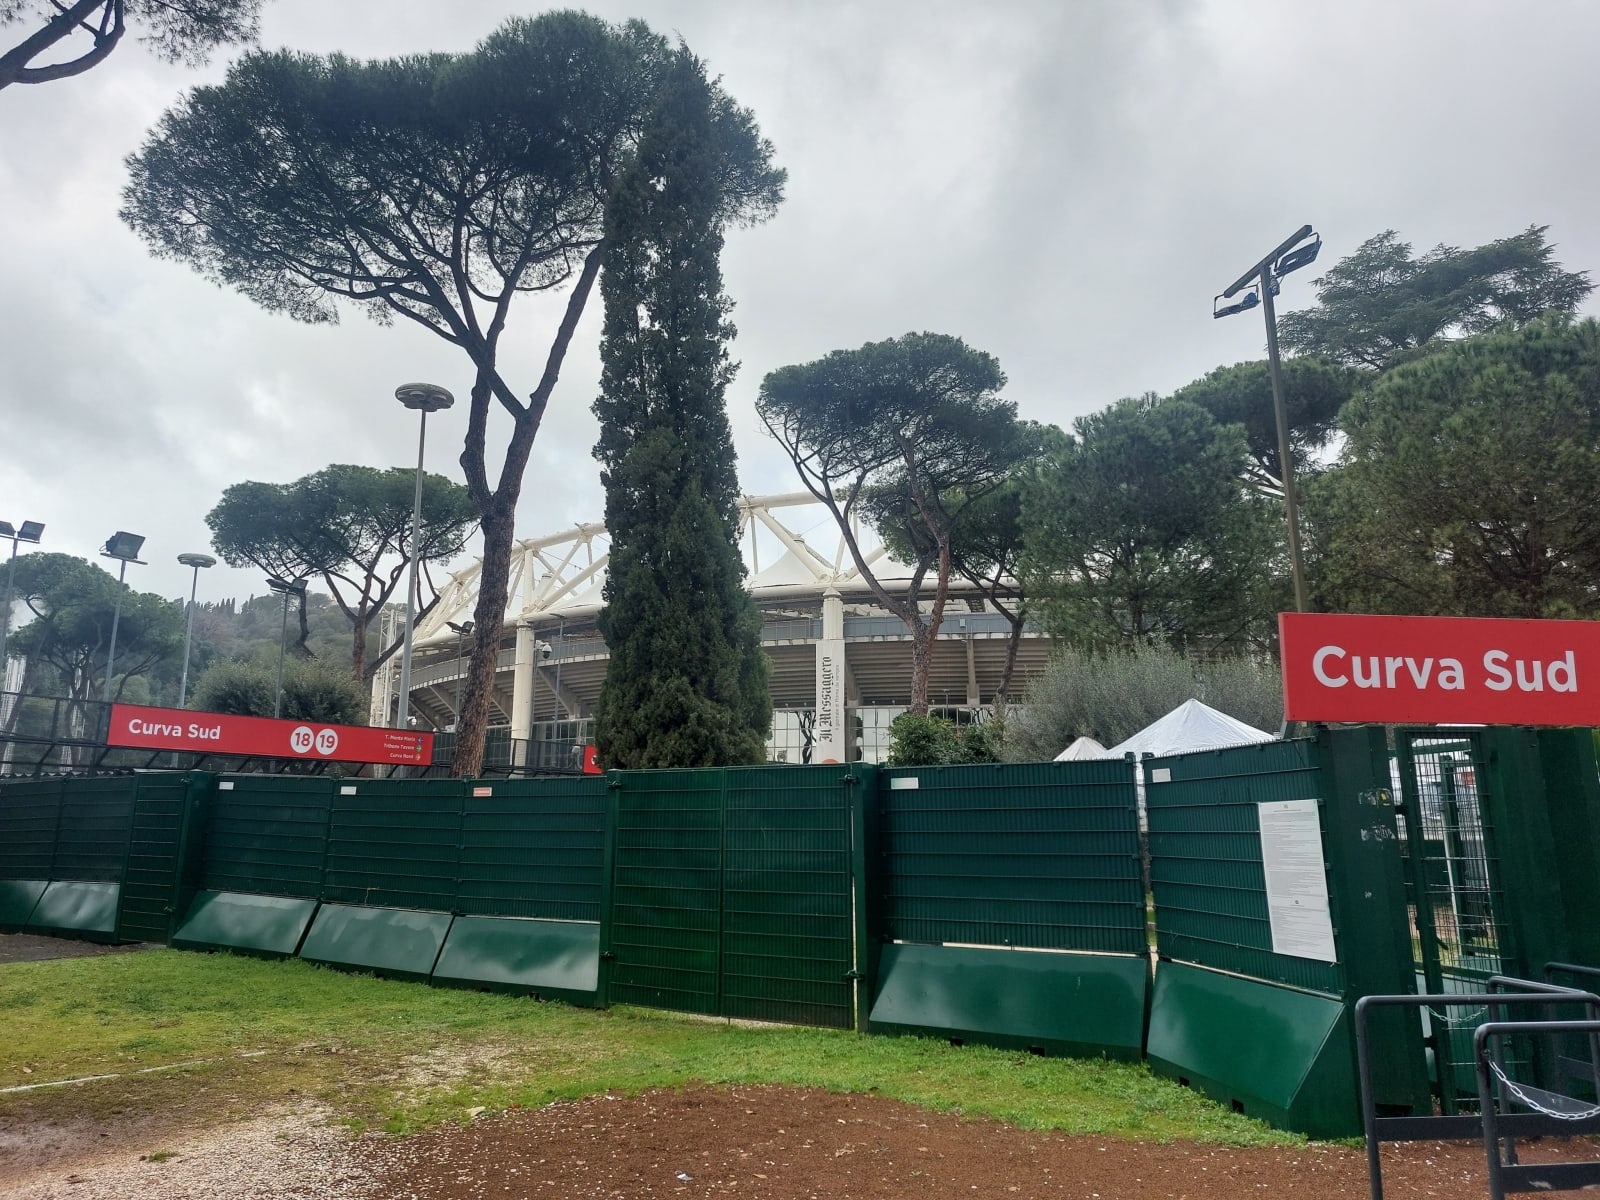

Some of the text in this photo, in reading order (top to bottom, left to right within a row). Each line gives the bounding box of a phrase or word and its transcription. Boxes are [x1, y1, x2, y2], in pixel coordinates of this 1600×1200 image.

[1312, 645, 1578, 693] Curva Sud
[819, 656, 834, 743] Il Messaggero
[128, 719, 221, 740] Curva Sud
[294, 732, 335, 749] 18 19
